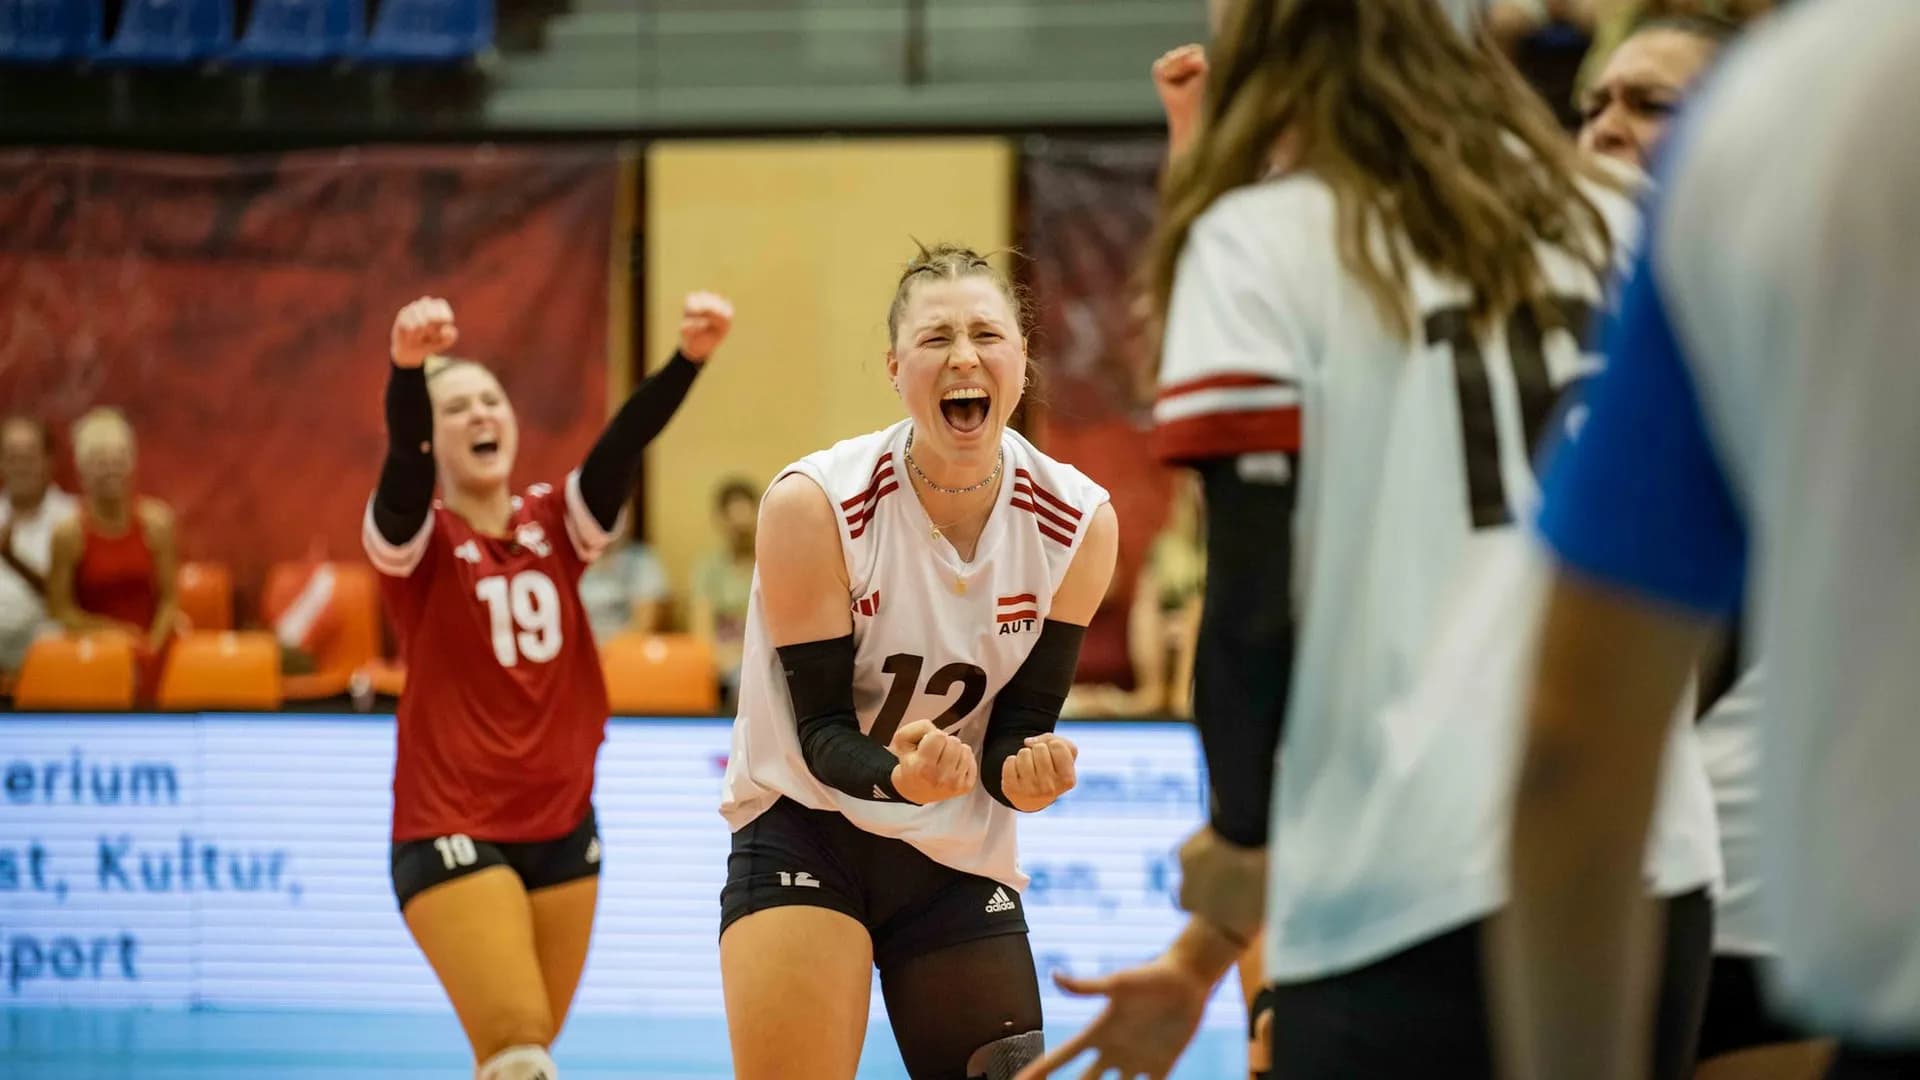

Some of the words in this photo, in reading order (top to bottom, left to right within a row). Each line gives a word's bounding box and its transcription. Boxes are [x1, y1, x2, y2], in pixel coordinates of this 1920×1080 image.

[475, 569, 563, 667] 19
[999, 619, 1035, 636] AUT
[868, 652, 988, 747] 12
[97, 833, 304, 905] Kultur,
[776, 871, 820, 888] 12
[985, 900, 1015, 913] adidas
[0, 931, 140, 994] port
